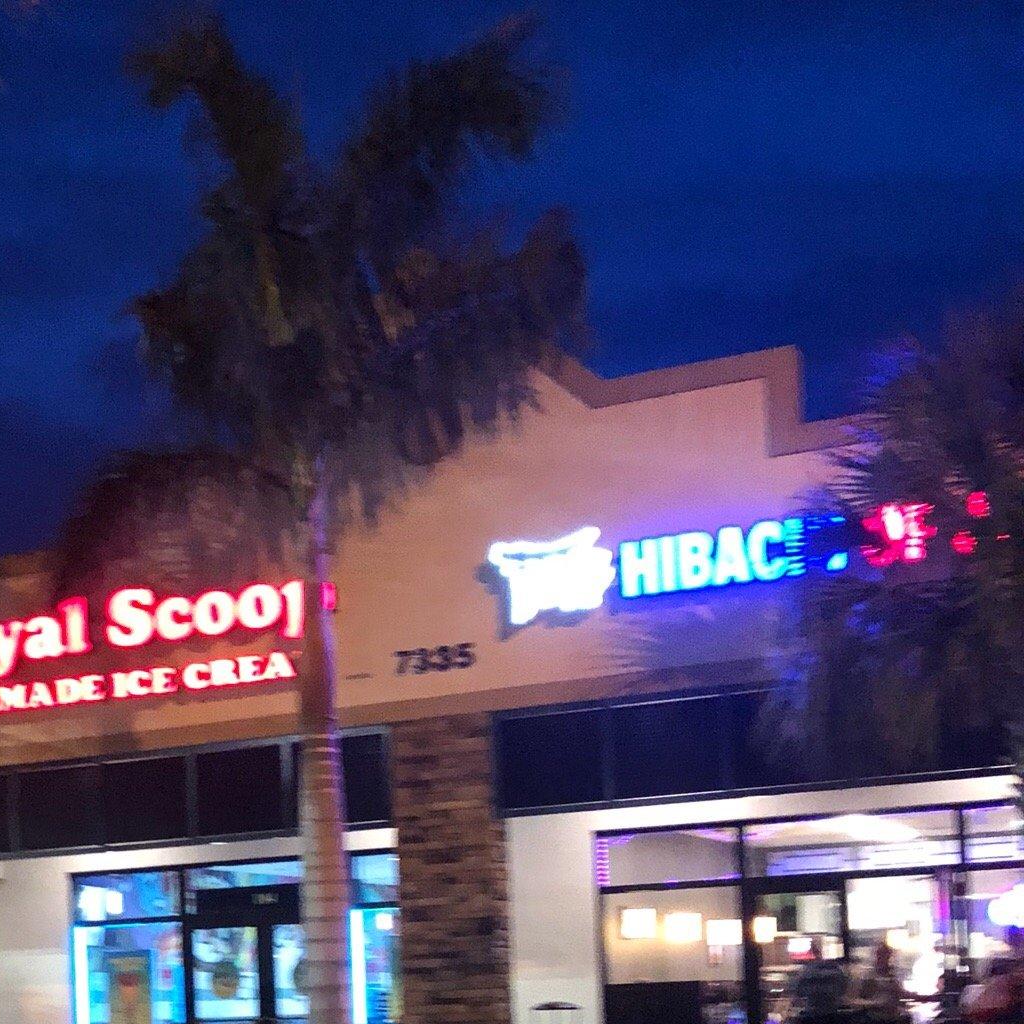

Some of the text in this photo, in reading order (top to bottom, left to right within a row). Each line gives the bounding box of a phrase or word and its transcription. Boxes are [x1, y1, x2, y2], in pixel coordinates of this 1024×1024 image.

[619, 513, 848, 599] HIBAC
[110, 666, 178, 700] ICE
[181, 649, 299, 691] CREA
